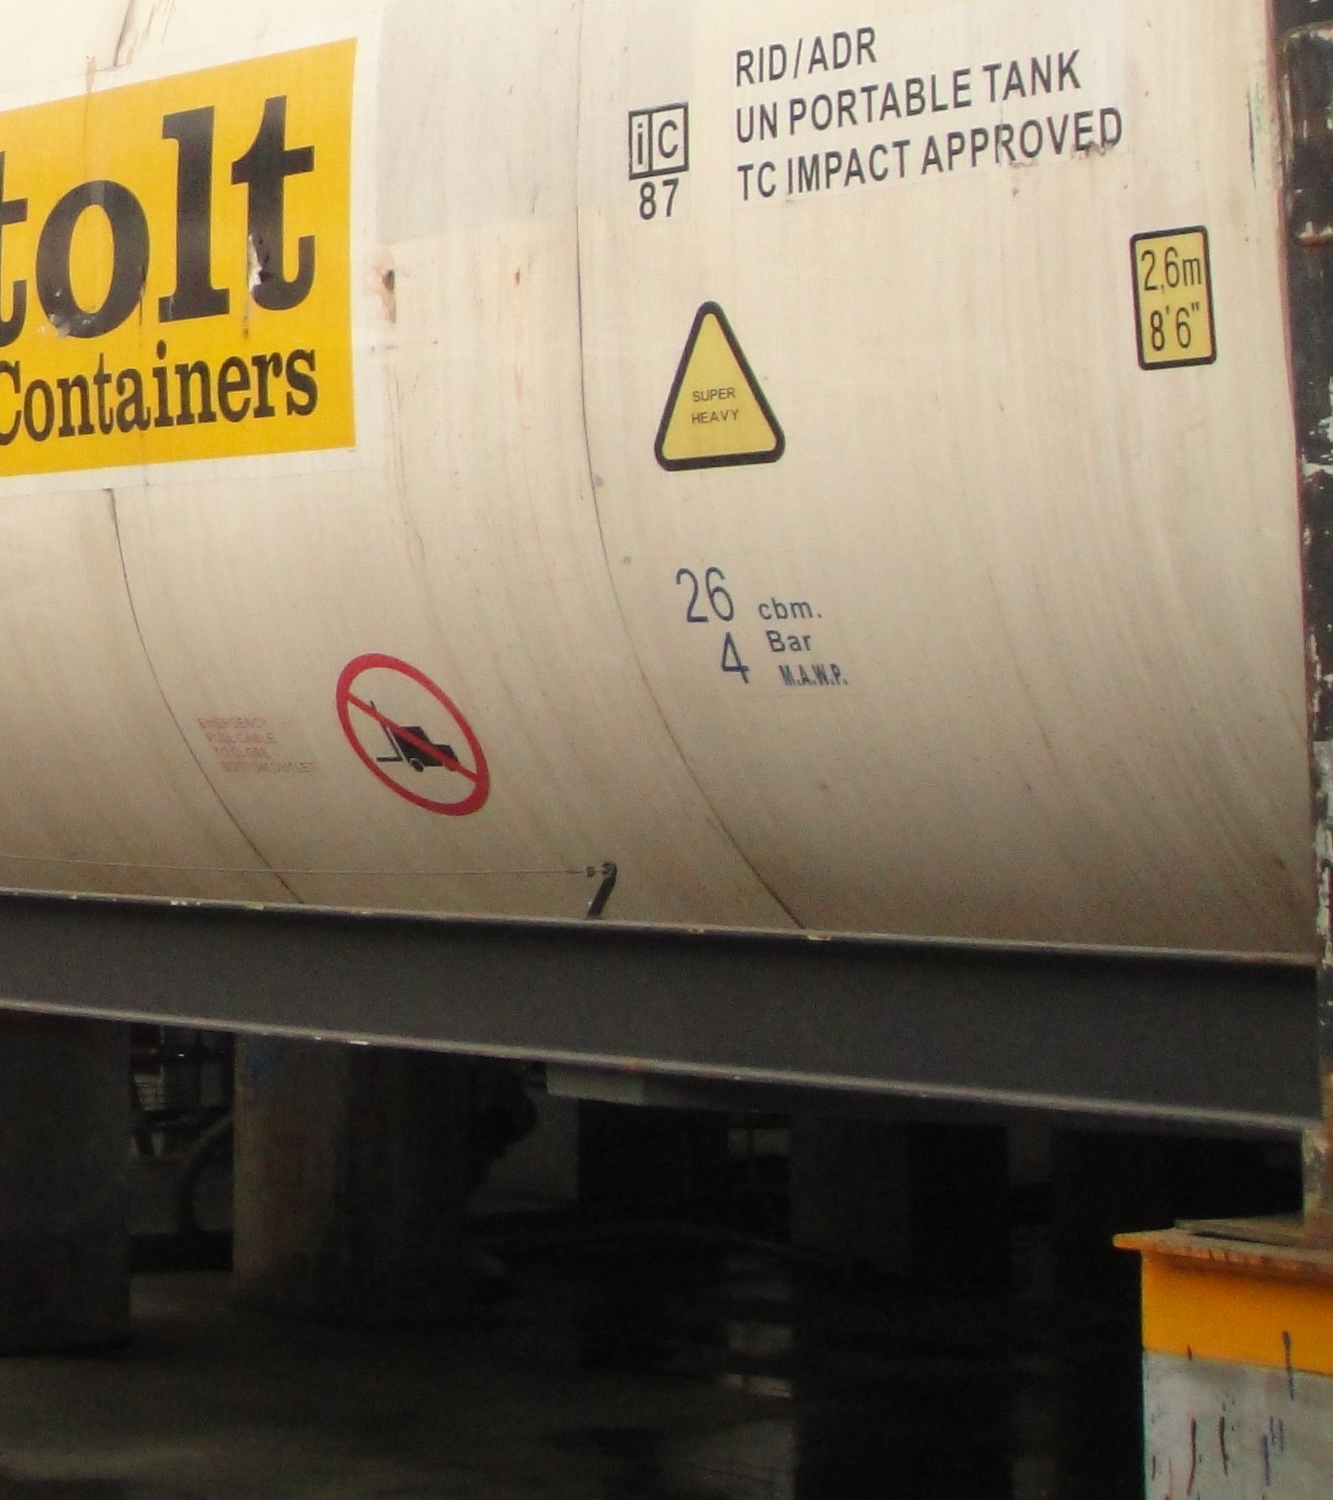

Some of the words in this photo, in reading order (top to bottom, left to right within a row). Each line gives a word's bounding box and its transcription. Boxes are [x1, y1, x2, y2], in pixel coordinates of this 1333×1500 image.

[735, 26, 878, 87] RID/ADR
[735, 101, 779, 143] UN
[789, 68, 972, 136] PORTABLE
[982, 49, 1082, 102] TANK
[737, 161, 777, 202] TC
[786, 139, 911, 196] IMPACT
[921, 106, 1123, 176] APPROVED
[639, 177, 680, 221] 87
[691, 409, 740, 426] HEAVY
[692, 386, 737, 404] SUPER
[676, 566, 734, 623] 26
[758, 597, 823, 621] cbm.
[720, 631, 750, 684] 4
[766, 630, 812, 652] Bar
[778, 663, 849, 686] M.A.W.P.
[197, 716, 268, 729] EMERGENCY
